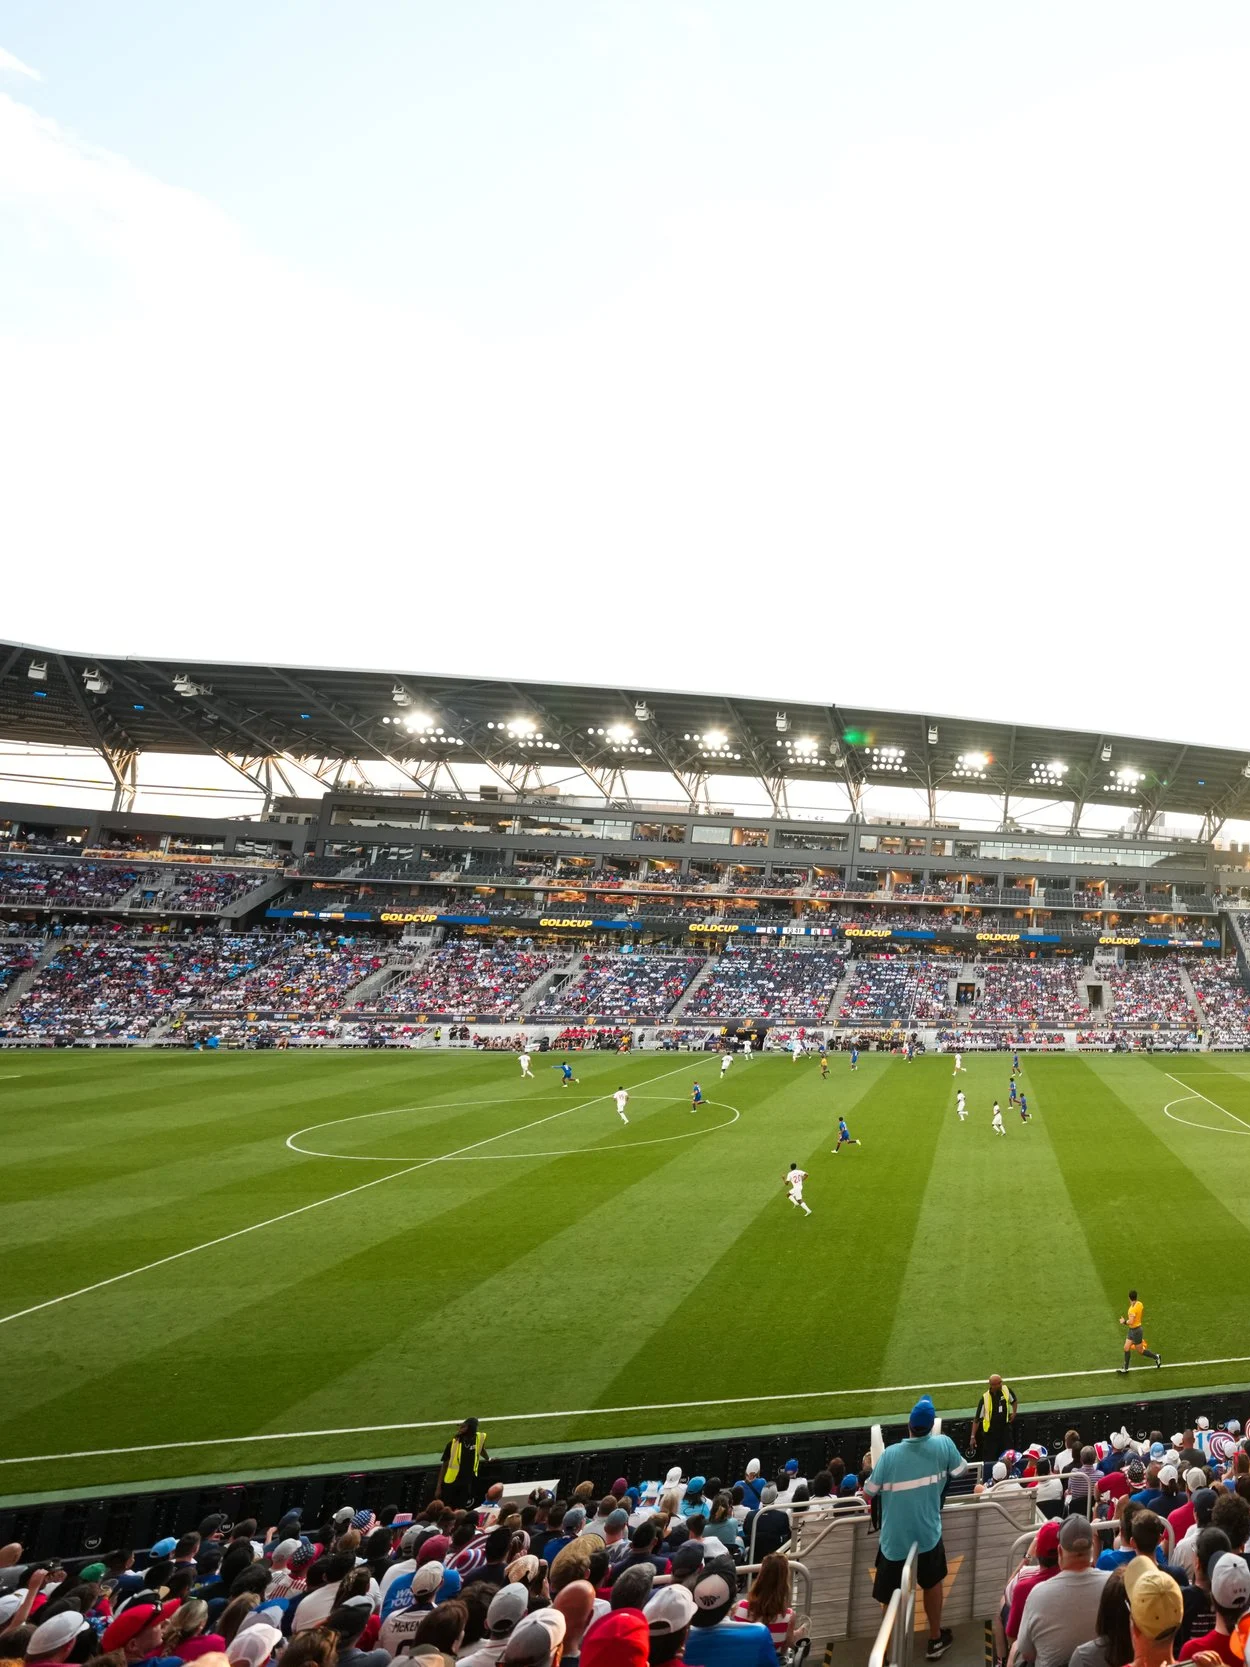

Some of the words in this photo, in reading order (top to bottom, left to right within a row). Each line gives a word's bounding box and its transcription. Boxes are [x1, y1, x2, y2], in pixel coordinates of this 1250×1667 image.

[380, 913, 437, 923] GOLDCUP
[539, 918, 593, 927] GOLDCUP
[689, 924, 739, 932] GOLDCUP
[844, 929, 892, 937] GOLDCUP
[976, 933, 1020, 941] GOLDCUP
[1099, 936, 1140, 945] GOLDCUP
[392, 1620, 423, 1633] McKEN
